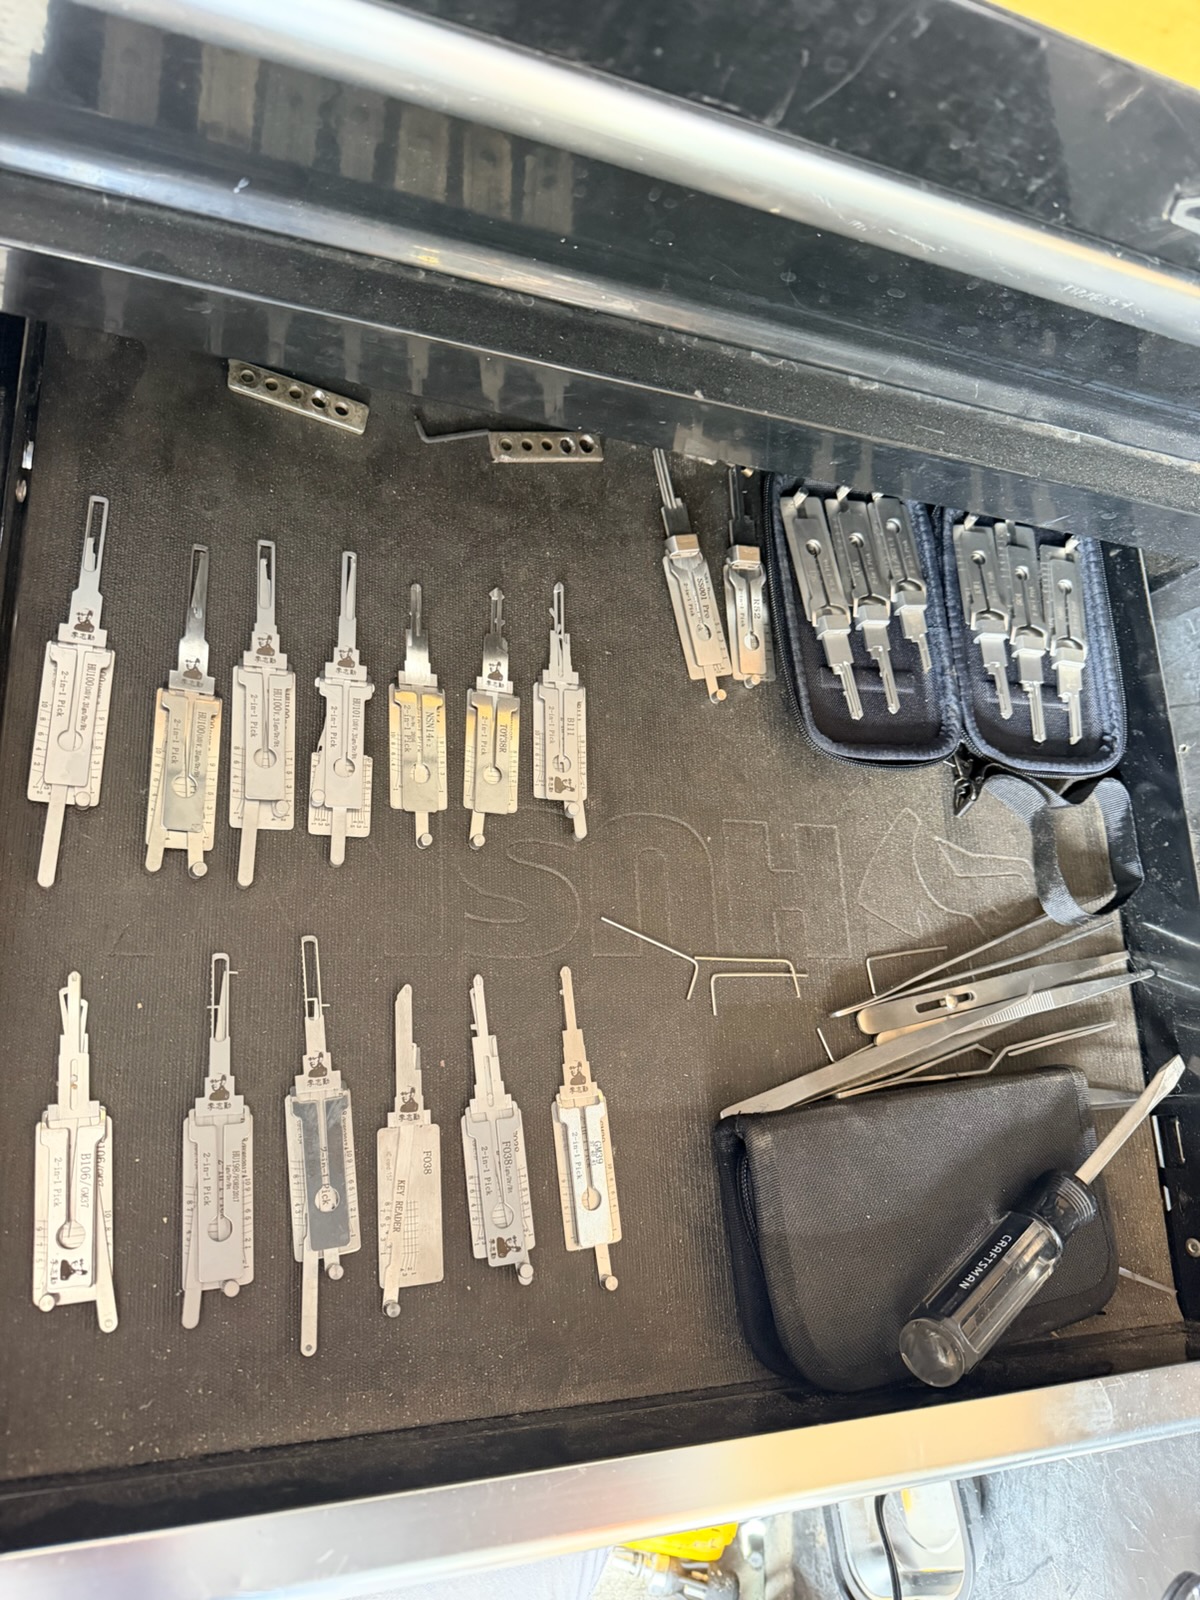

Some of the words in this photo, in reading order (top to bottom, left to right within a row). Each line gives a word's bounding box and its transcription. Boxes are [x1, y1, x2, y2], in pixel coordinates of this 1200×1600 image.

[683, 583, 691, 601] 2-in-1
[59, 670, 69, 696] 2-in-1
[56, 699, 67, 717] Pick
[250, 694, 258, 717] 2-in-1
[330, 705, 338, 729] 2-in-1
[173, 718, 181, 744] 2-in-1
[250, 721, 258, 738] Pick
[330, 732, 338, 748] Pick
[171, 746, 179, 764] Pick
[572, 1132, 580, 1158] 2-in-1
[594, 1140, 603, 1165] GM39
[54, 1157, 63, 1184] 2-in-1
[203, 1152, 211, 1181] 2-in-1
[422, 1150, 432, 1175] F038
[481, 1146, 490, 1173] 2-in-1
[575, 1161, 583, 1180] Pick
[80, 1153, 92, 1208] B106/GM37
[396, 1179, 406, 1196] KEY
[485, 1176, 493, 1196] Pick
[53, 1188, 62, 1207] Pick
[203, 1185, 212, 1206] Pick
[320, 1183, 331, 1206] Pick
[393, 1200, 404, 1233] READER
[958, 1234, 1012, 1290] CRAFTSMAN
